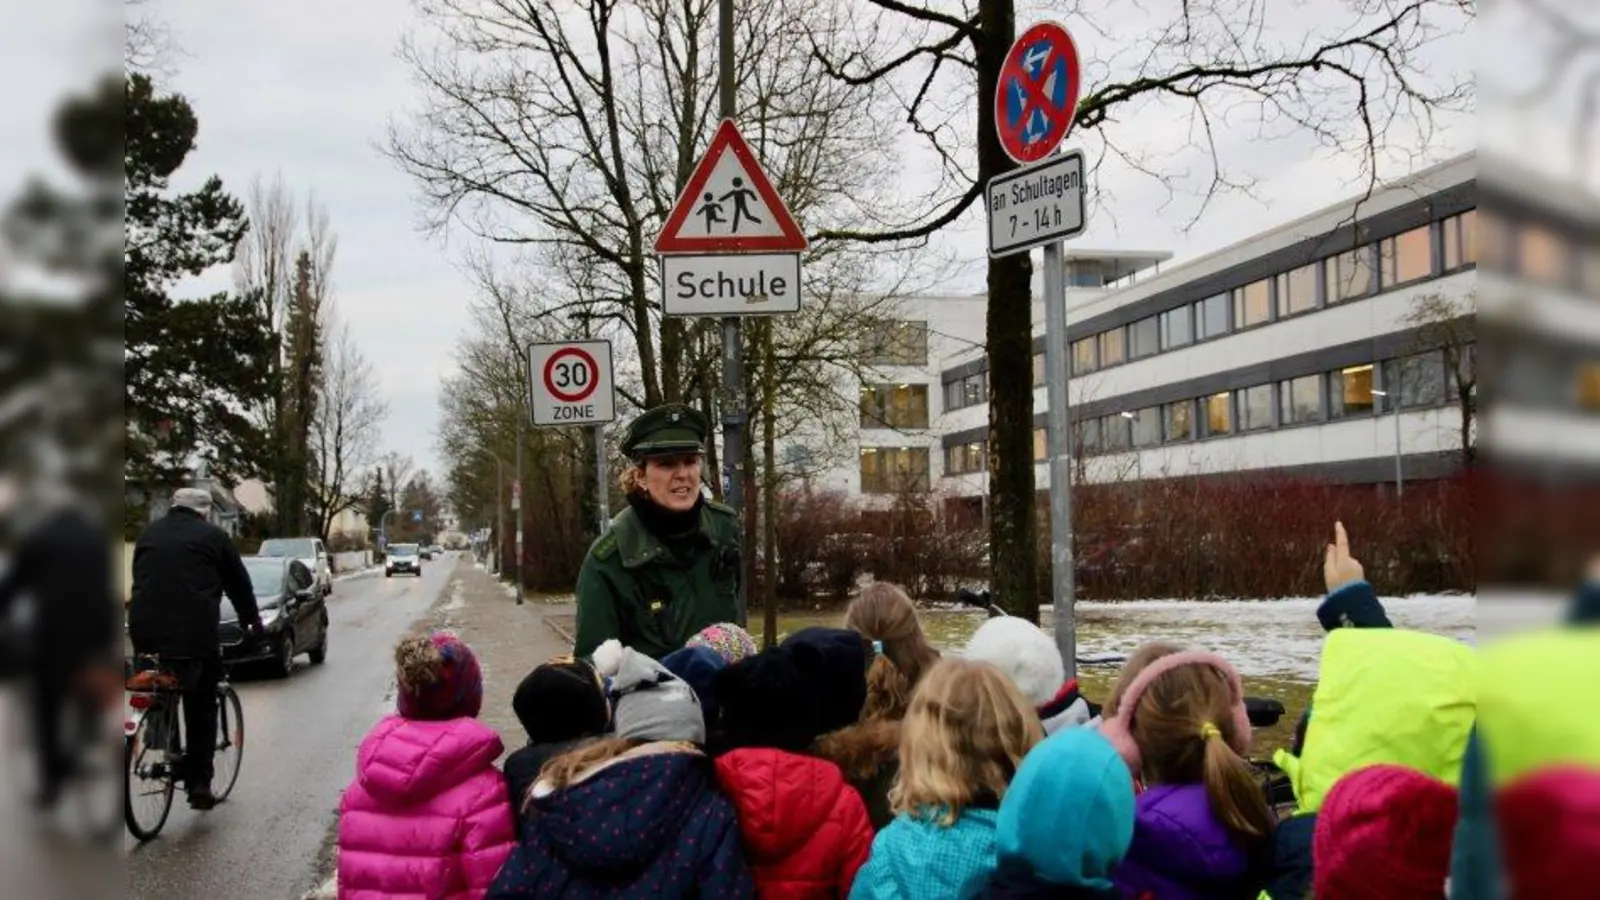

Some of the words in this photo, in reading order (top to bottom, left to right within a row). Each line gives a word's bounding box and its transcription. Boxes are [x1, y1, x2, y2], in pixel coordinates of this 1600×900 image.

[993, 192, 1006, 211] an
[1012, 170, 1078, 205] Schultagen
[677, 270, 786, 299] Schule
[555, 362, 588, 387] 30
[553, 404, 595, 420] ZONE
